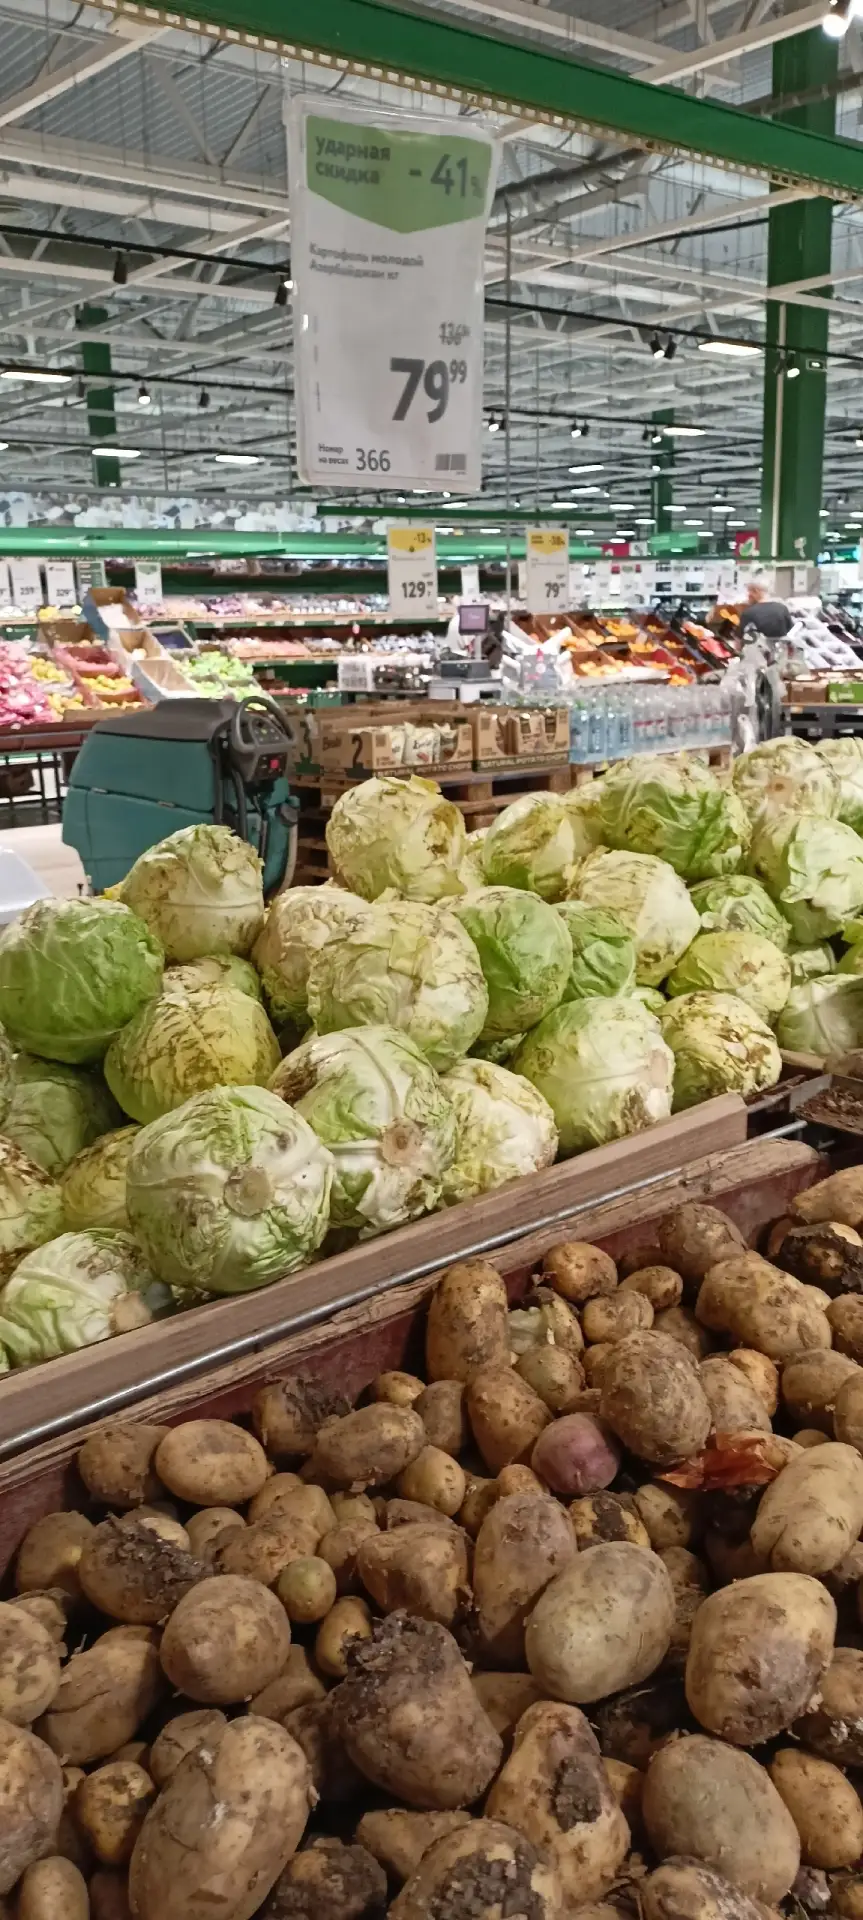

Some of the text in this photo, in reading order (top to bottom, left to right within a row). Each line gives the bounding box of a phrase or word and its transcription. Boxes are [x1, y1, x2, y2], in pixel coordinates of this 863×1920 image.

[315, 135, 391, 162] ударная
[315, 161, 380, 185] скидка
[309, 242, 424, 266] Картофель молодой
[309, 259, 384, 279] Азербайджан
[318, 443, 343, 454] Номер
[355, 447, 391, 472] 366
[401, 581, 426, 599] 129
[544, 582, 559, 599] 79
